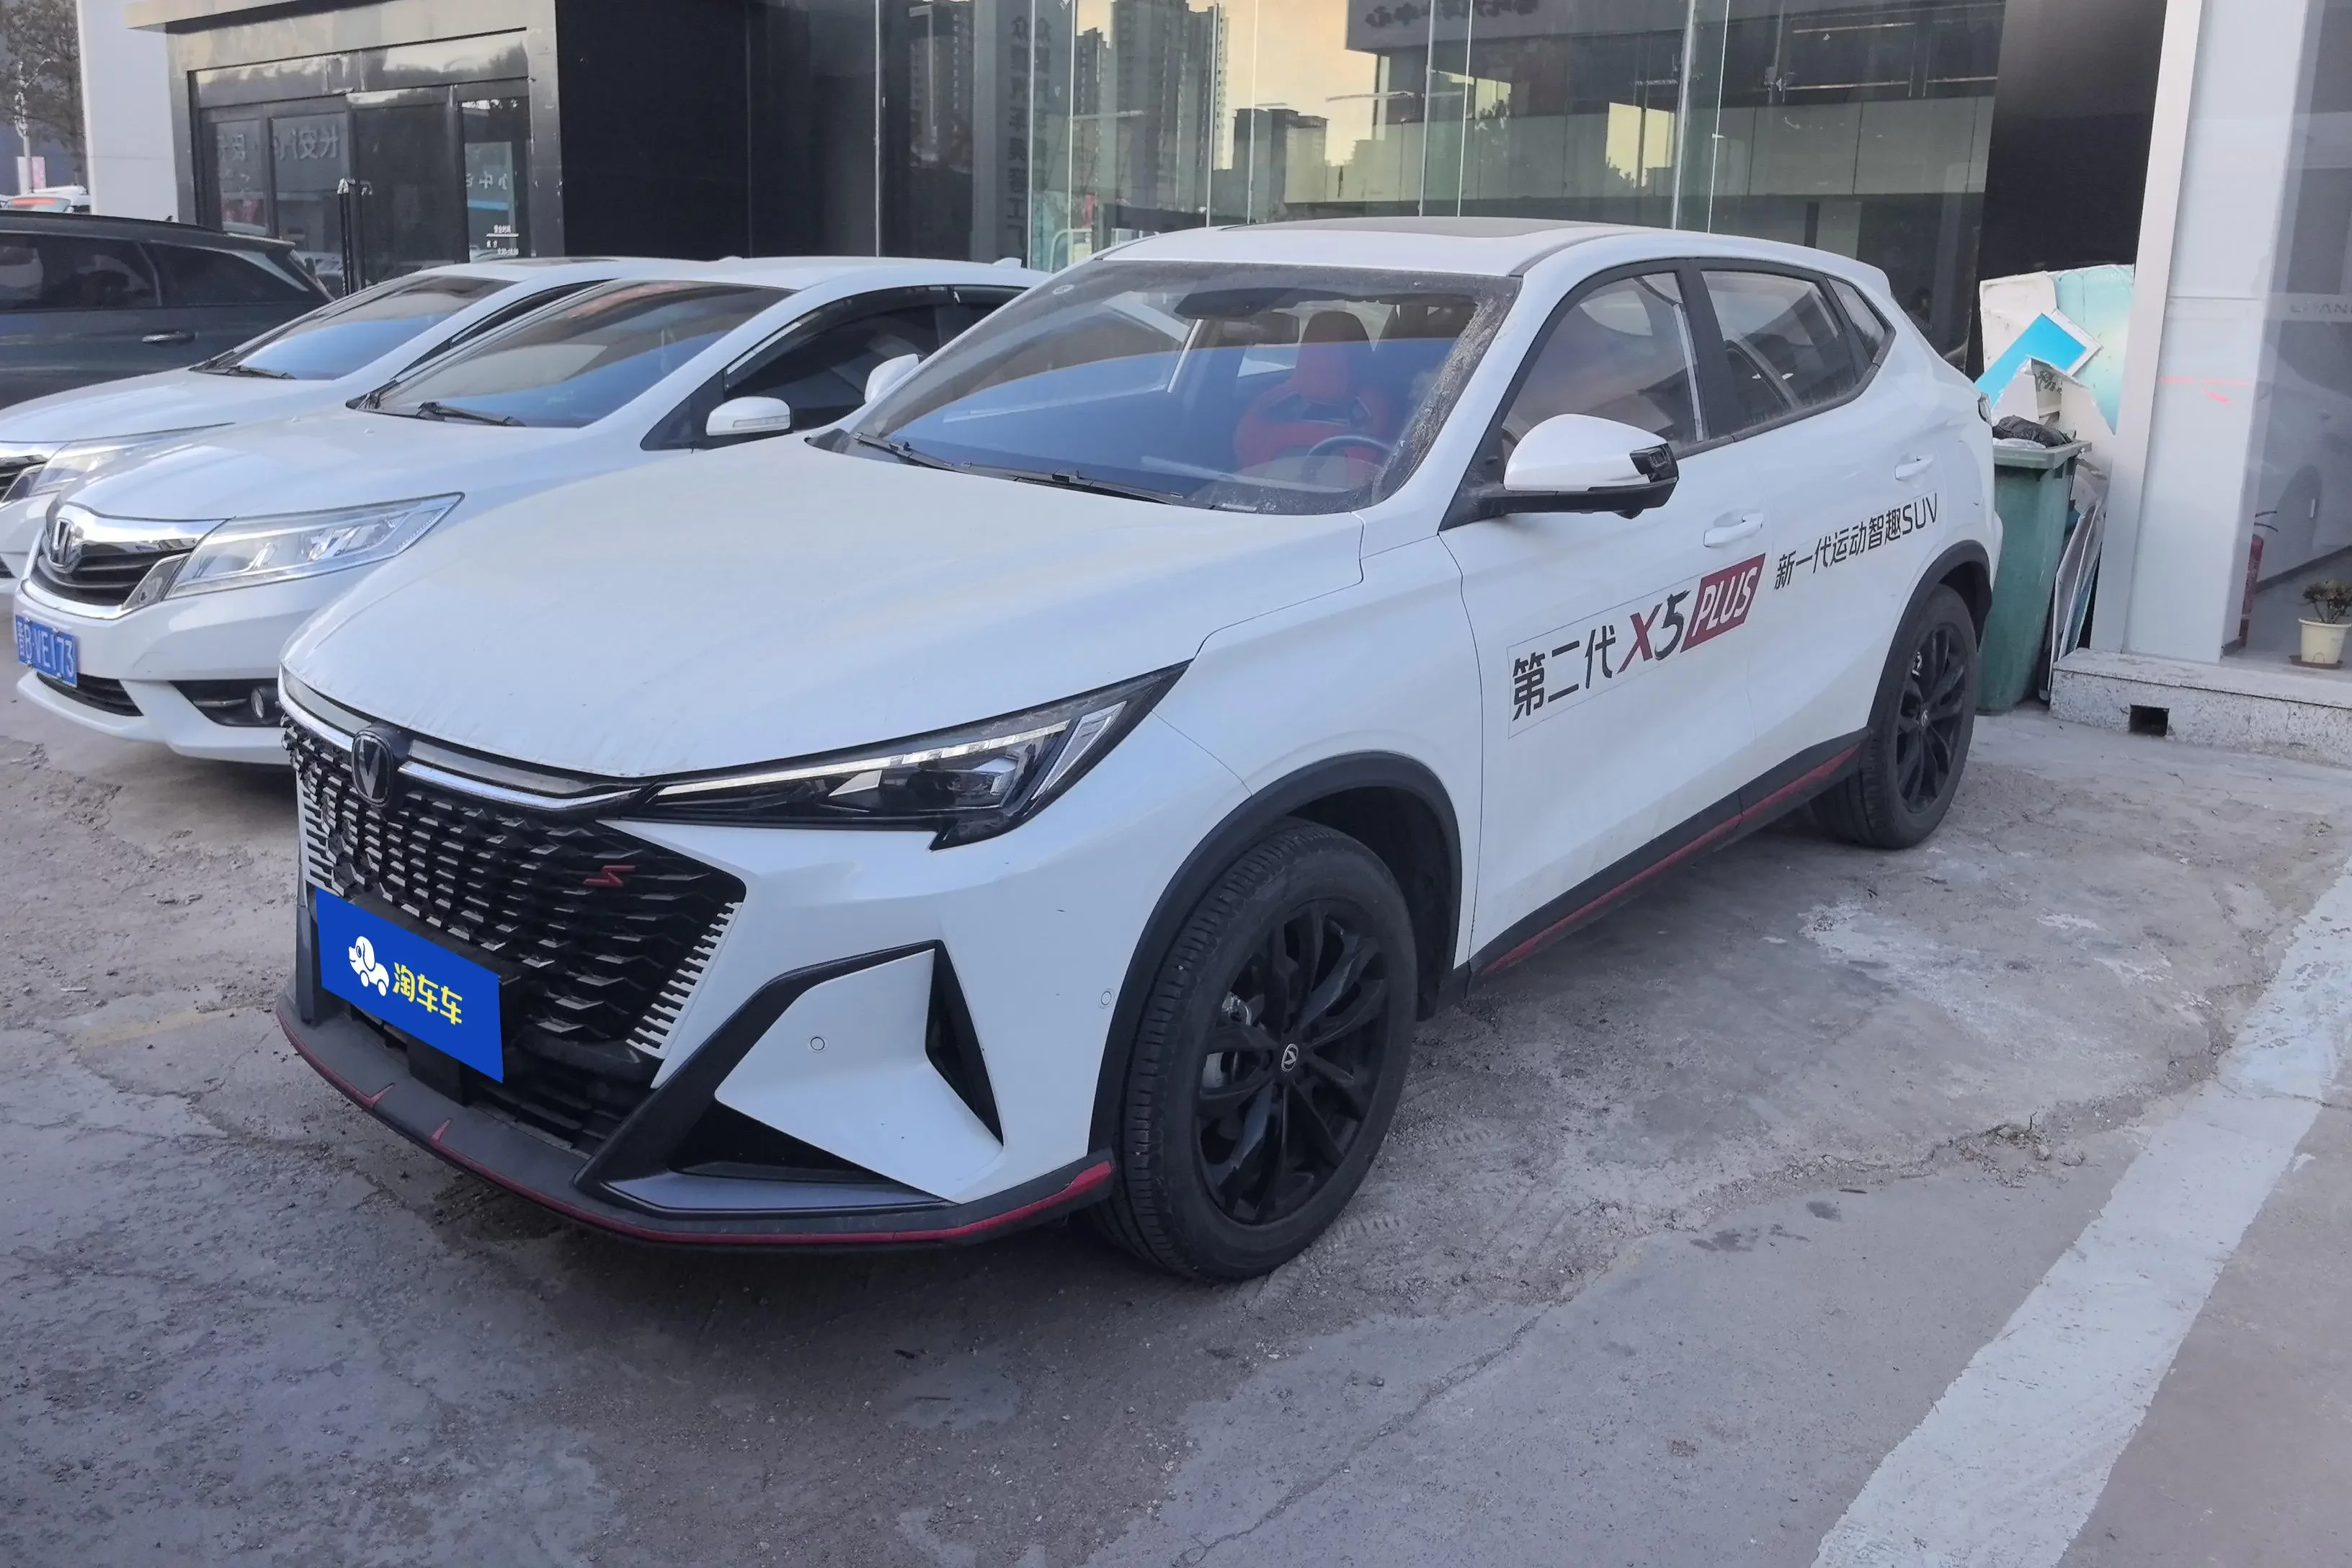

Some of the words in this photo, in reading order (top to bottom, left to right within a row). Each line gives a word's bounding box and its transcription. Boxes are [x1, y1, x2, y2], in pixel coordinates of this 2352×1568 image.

[1774, 493, 1938, 590] 新一代运动智趣SUV
[1513, 624, 1616, 721] 第二代
[1691, 566, 1758, 637] PLUS
